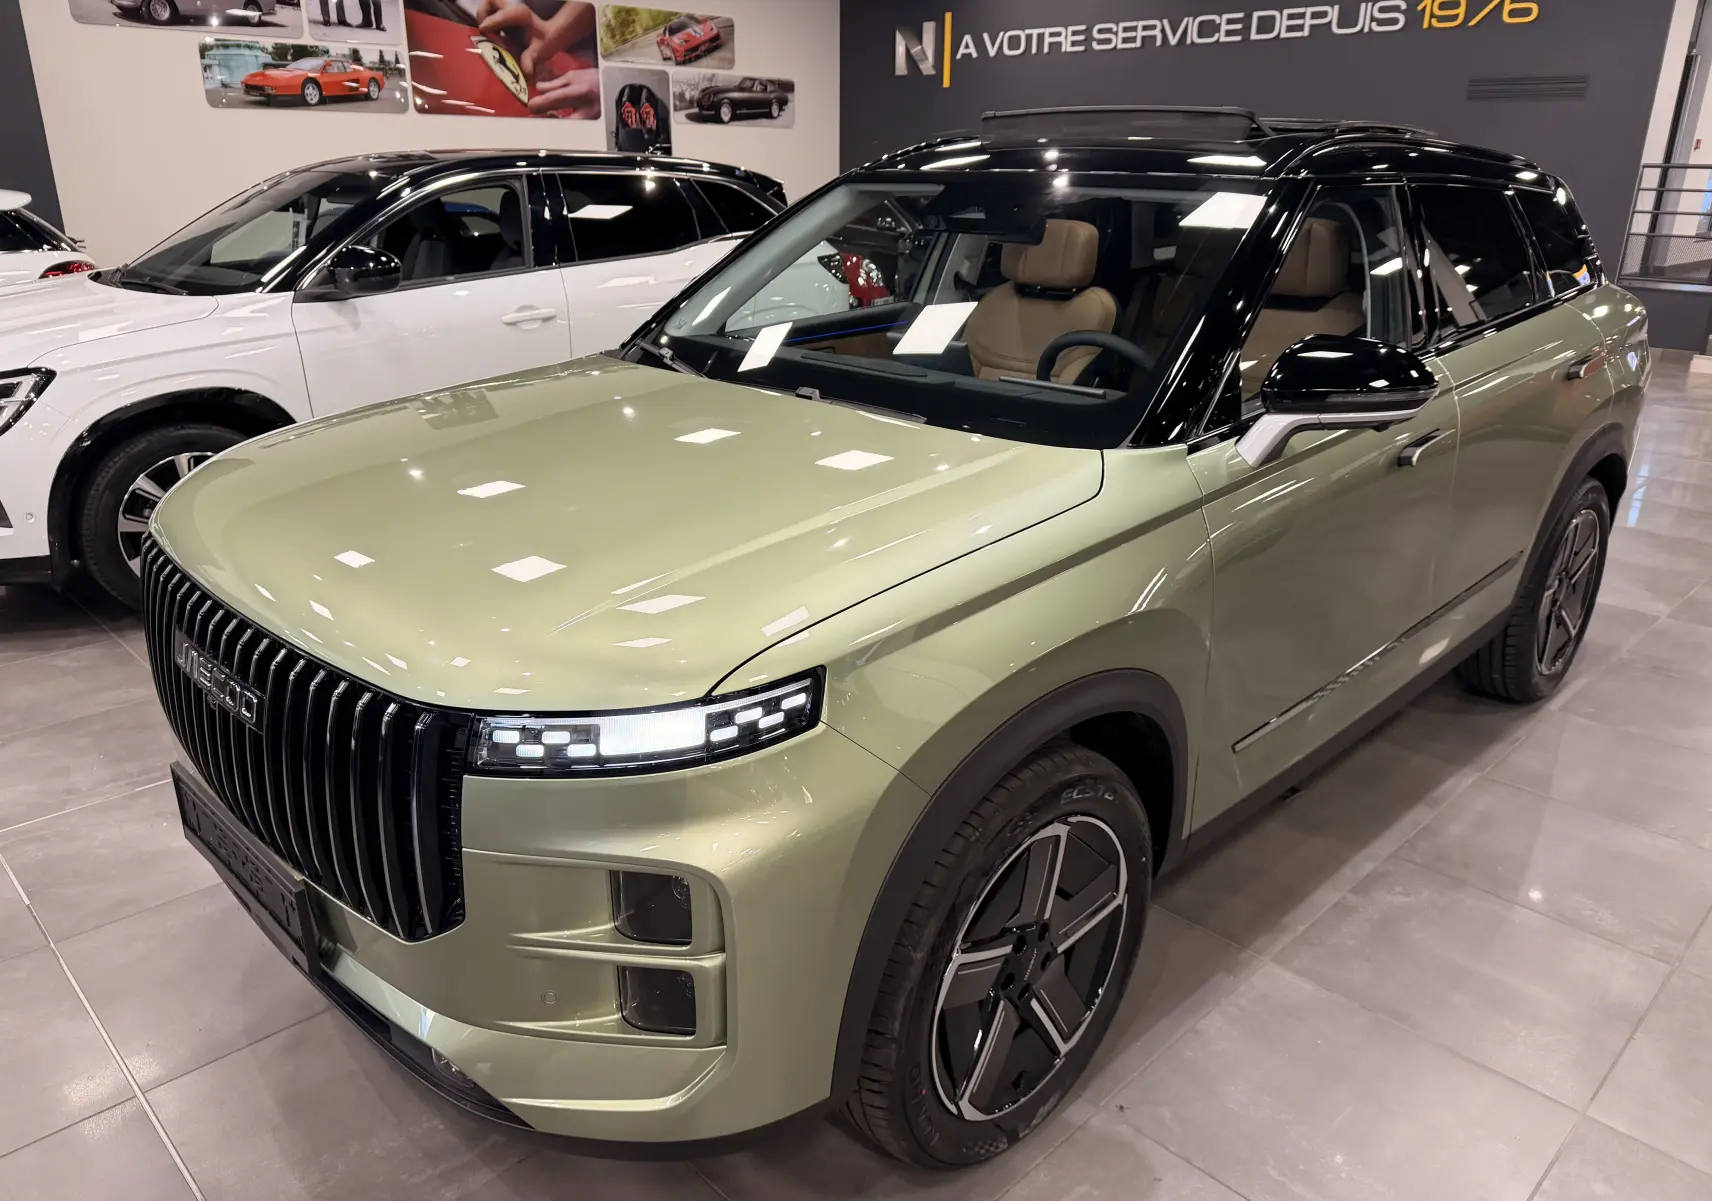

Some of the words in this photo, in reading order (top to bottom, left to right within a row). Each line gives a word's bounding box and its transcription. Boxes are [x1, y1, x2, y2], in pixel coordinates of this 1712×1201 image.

[956, 34, 978, 60] A
[983, 24, 1087, 57] VOTRE
[1091, 12, 1245, 50] SERVICE
[1249, 0, 1408, 41] DEPUIS
